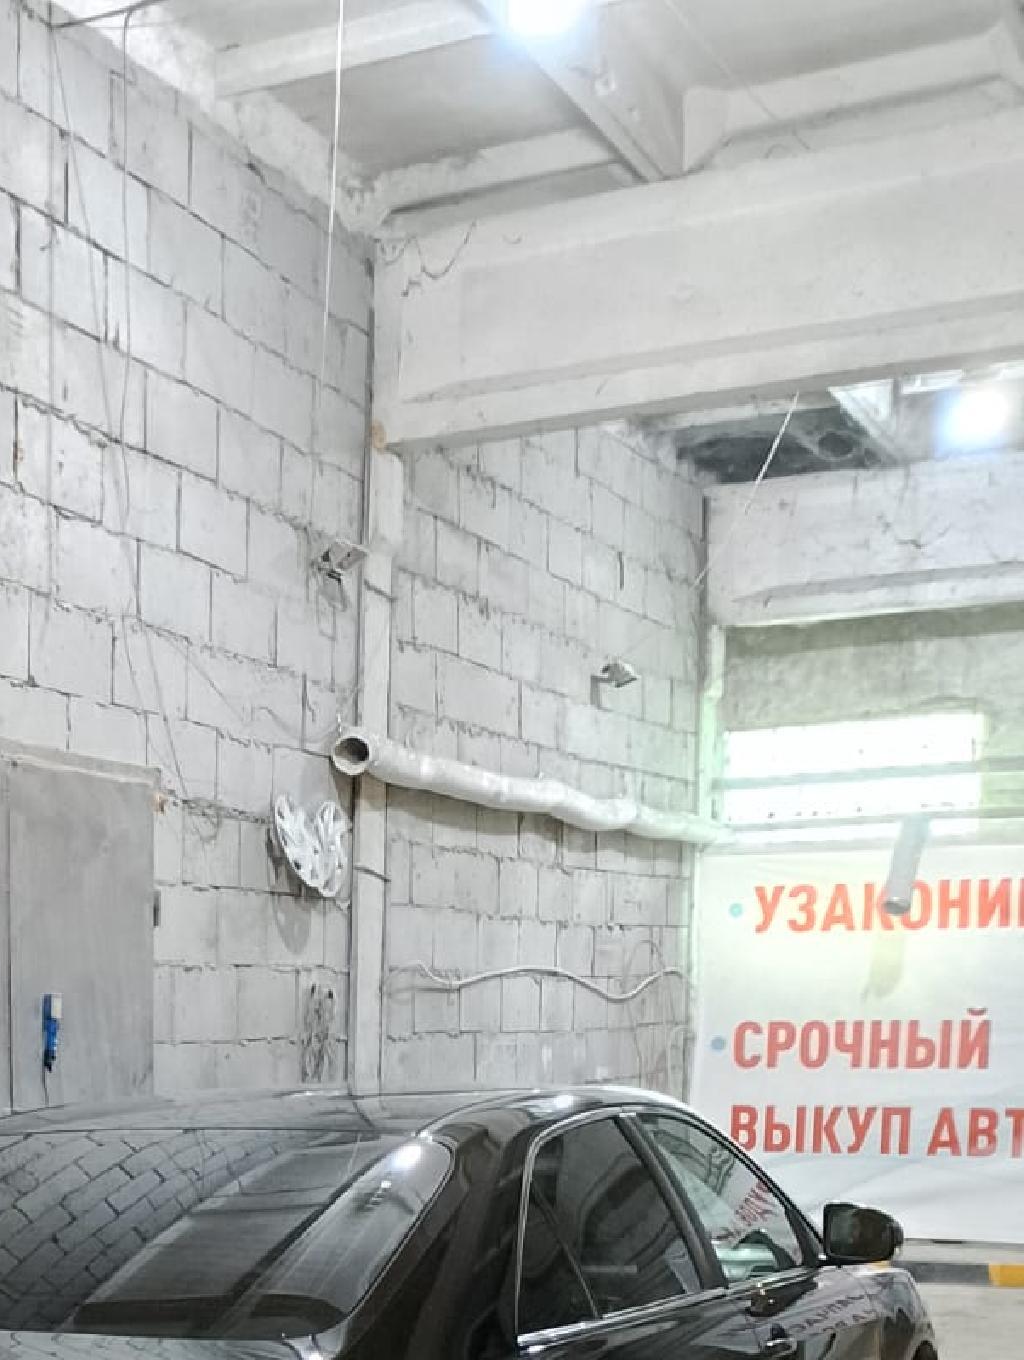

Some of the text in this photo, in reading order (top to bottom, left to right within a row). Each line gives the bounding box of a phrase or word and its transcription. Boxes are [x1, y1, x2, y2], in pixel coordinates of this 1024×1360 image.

[753, 877, 1024, 934] УЗАКОНИ
[732, 1007, 992, 1070] СРОЧНЫЙ
[730, 1104, 912, 1155] ВЫКУП
